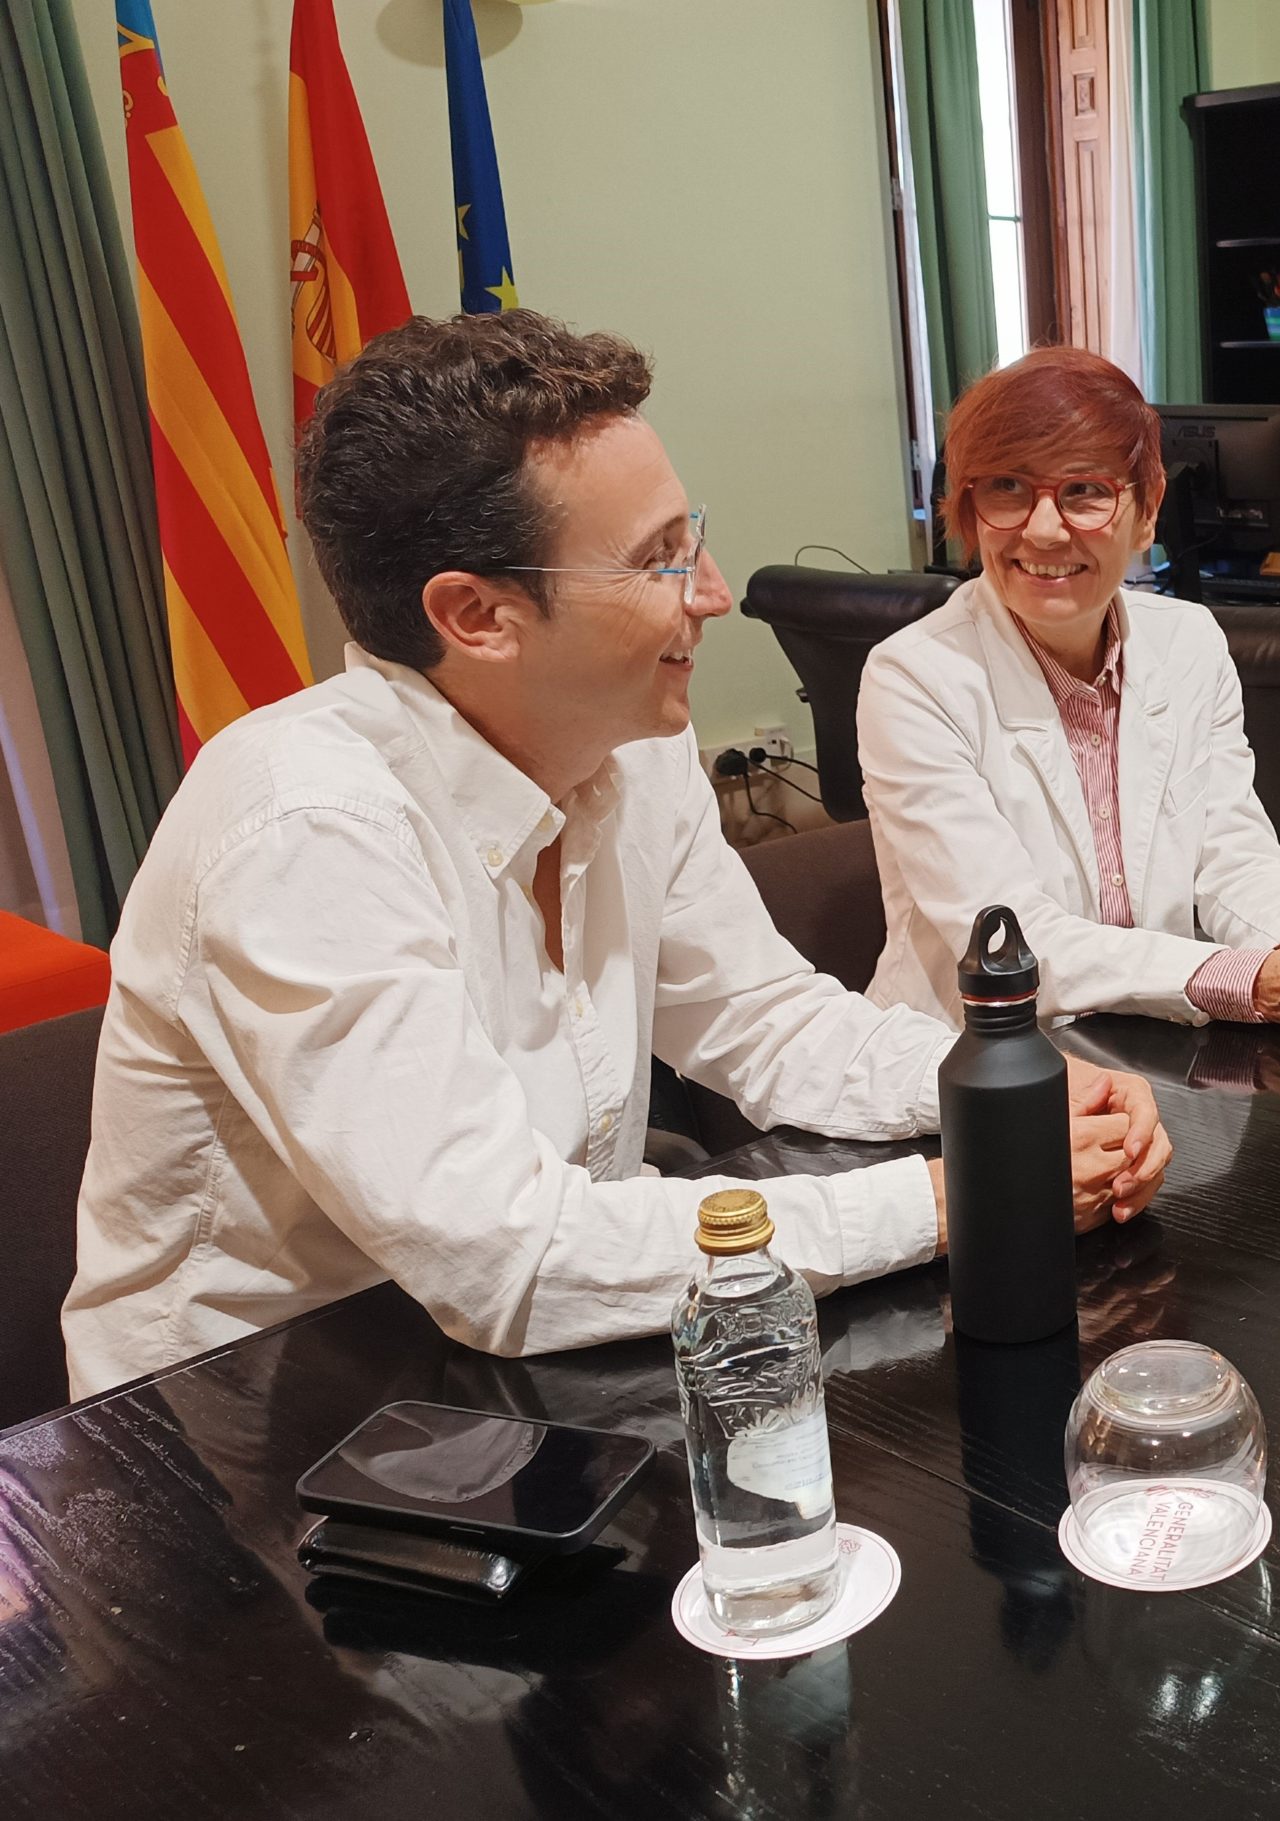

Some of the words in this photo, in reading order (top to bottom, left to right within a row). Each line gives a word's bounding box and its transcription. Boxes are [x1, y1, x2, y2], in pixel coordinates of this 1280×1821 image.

[1176, 425, 1216, 438] ASUS
[1127, 1501, 1171, 1576] VALENCIANA
[1149, 1501, 1194, 1581] GENERALITAT
